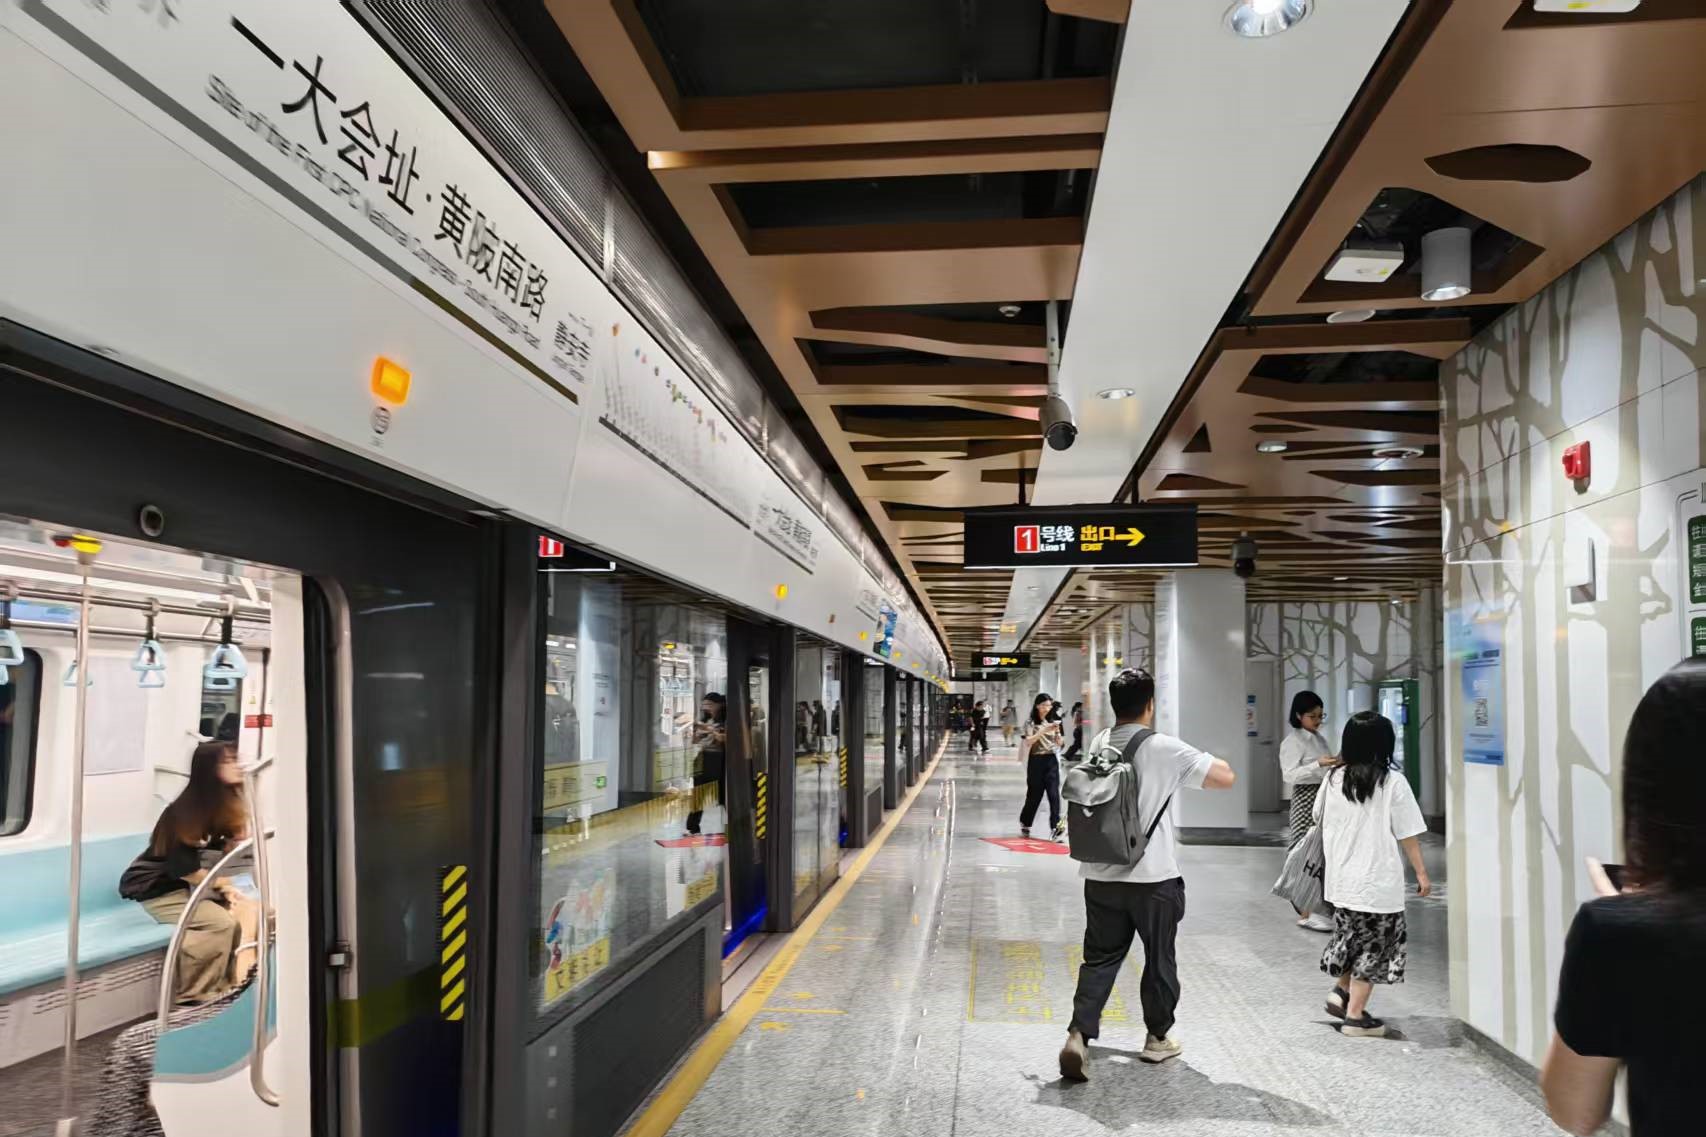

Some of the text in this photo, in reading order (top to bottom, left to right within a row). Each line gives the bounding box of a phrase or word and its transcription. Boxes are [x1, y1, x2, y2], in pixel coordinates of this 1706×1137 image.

[231, 16, 550, 323] 一大会址·黄陂南路
[1080, 525, 1115, 542] 出口
